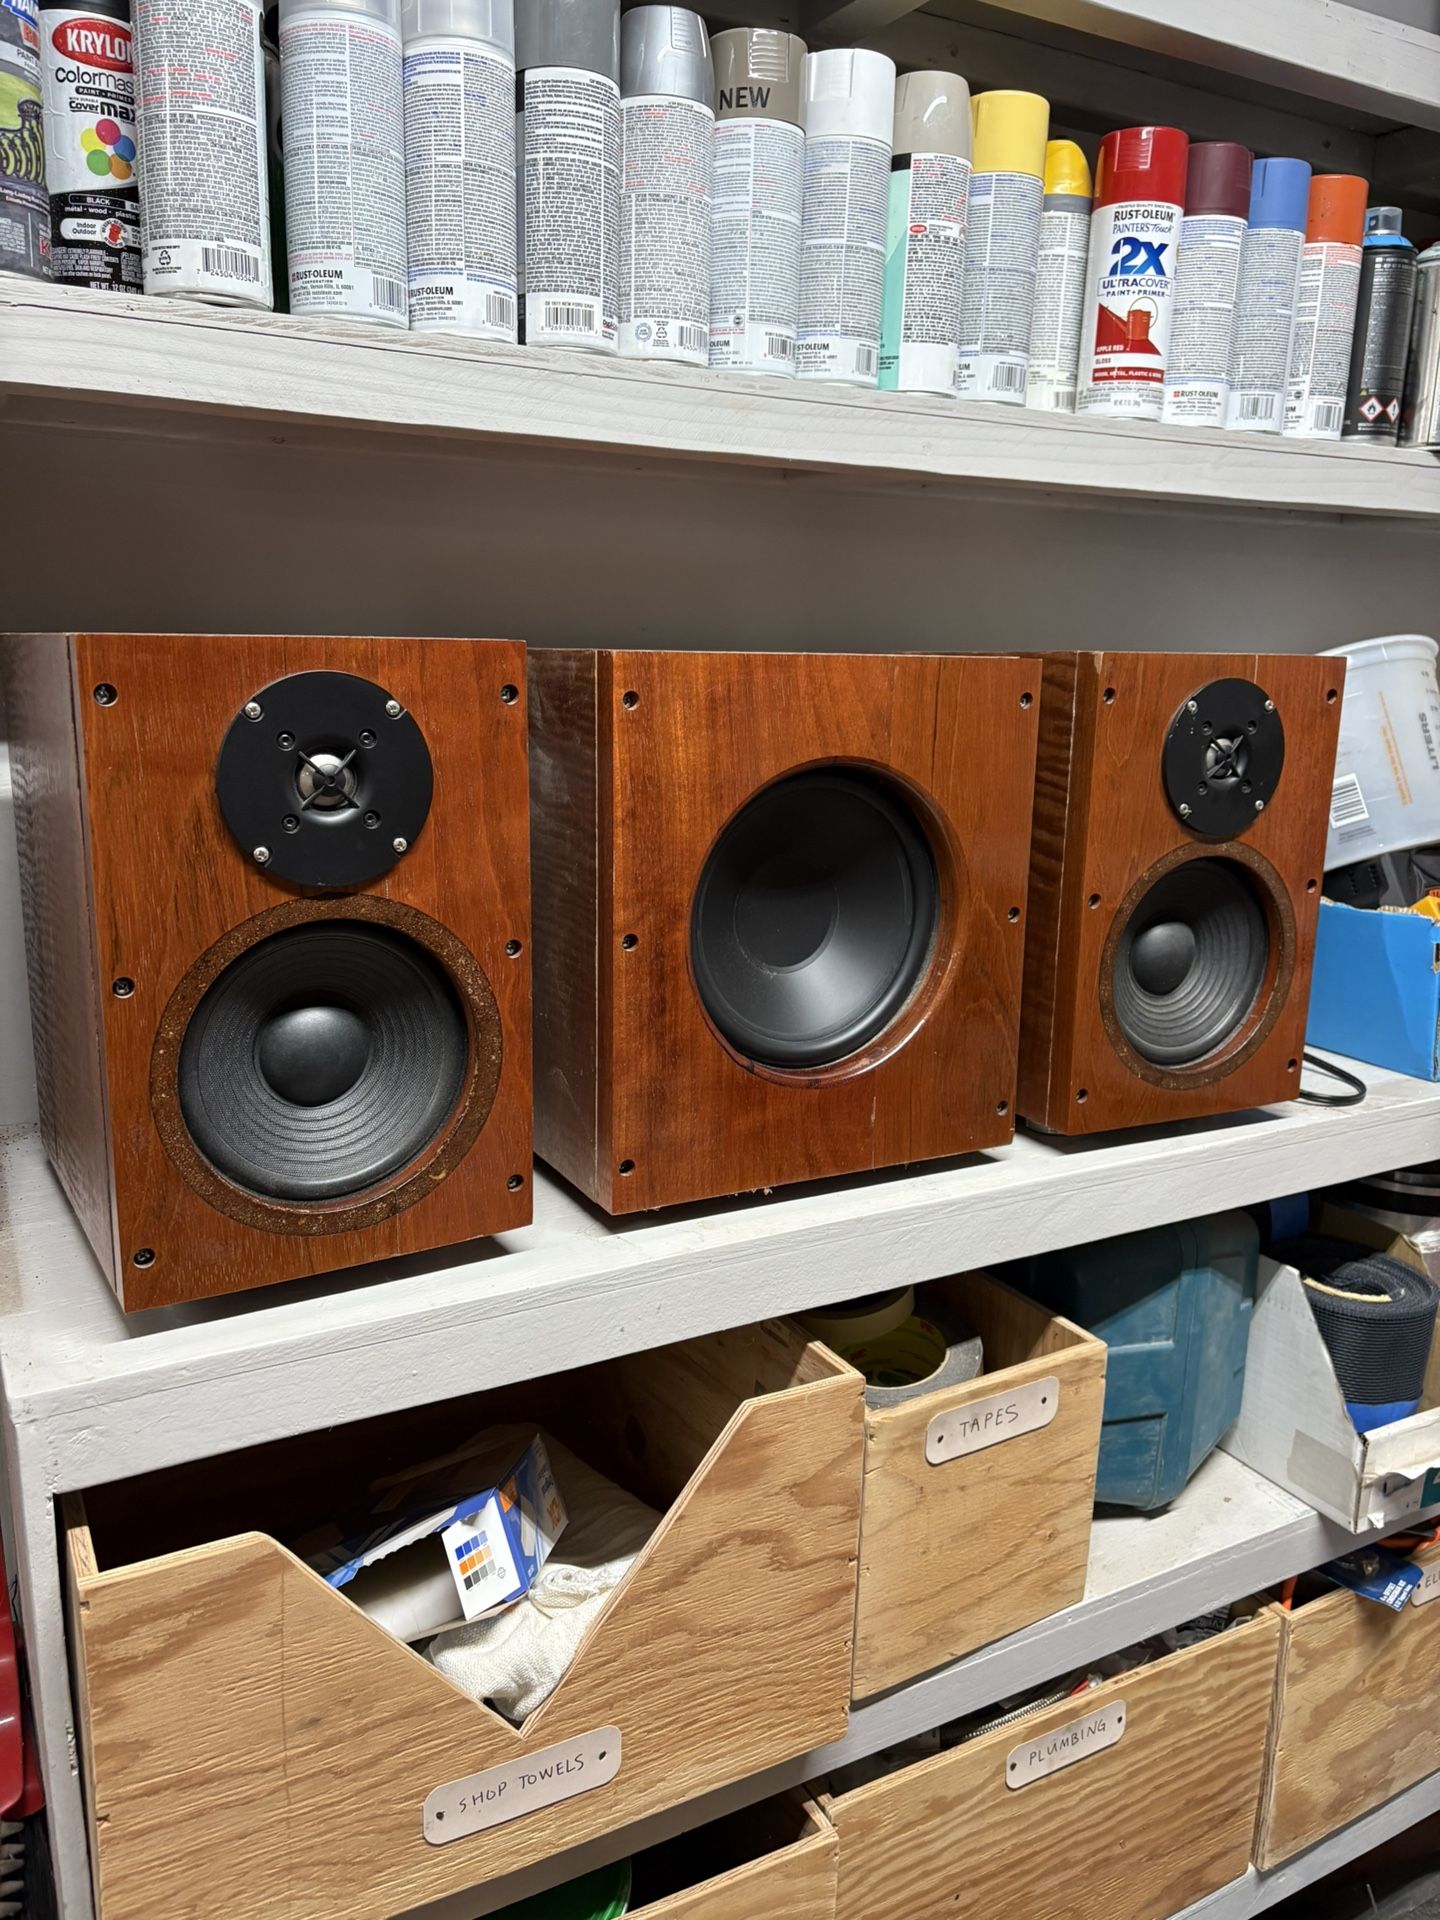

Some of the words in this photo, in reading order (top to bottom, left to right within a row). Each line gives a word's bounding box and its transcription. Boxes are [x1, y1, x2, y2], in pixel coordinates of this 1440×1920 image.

[55, 66, 134, 95] Colormas
[69, 100, 100, 111] Cover
[719, 86, 771, 110] NEW
[86, 196, 110, 205] BLACK
[1114, 209, 1173, 222] RUST-OLEUM
[1109, 236, 1169, 276] 2X
[1419, 712, 1440, 770] LITERS
[960, 1404, 1019, 1437] TAPES
[1425, 1570, 1440, 1589] EL
[1029, 1719, 1106, 1766] PLUMBING
[459, 1781, 507, 1813] SHOP
[518, 1754, 585, 1789] TOWELS
